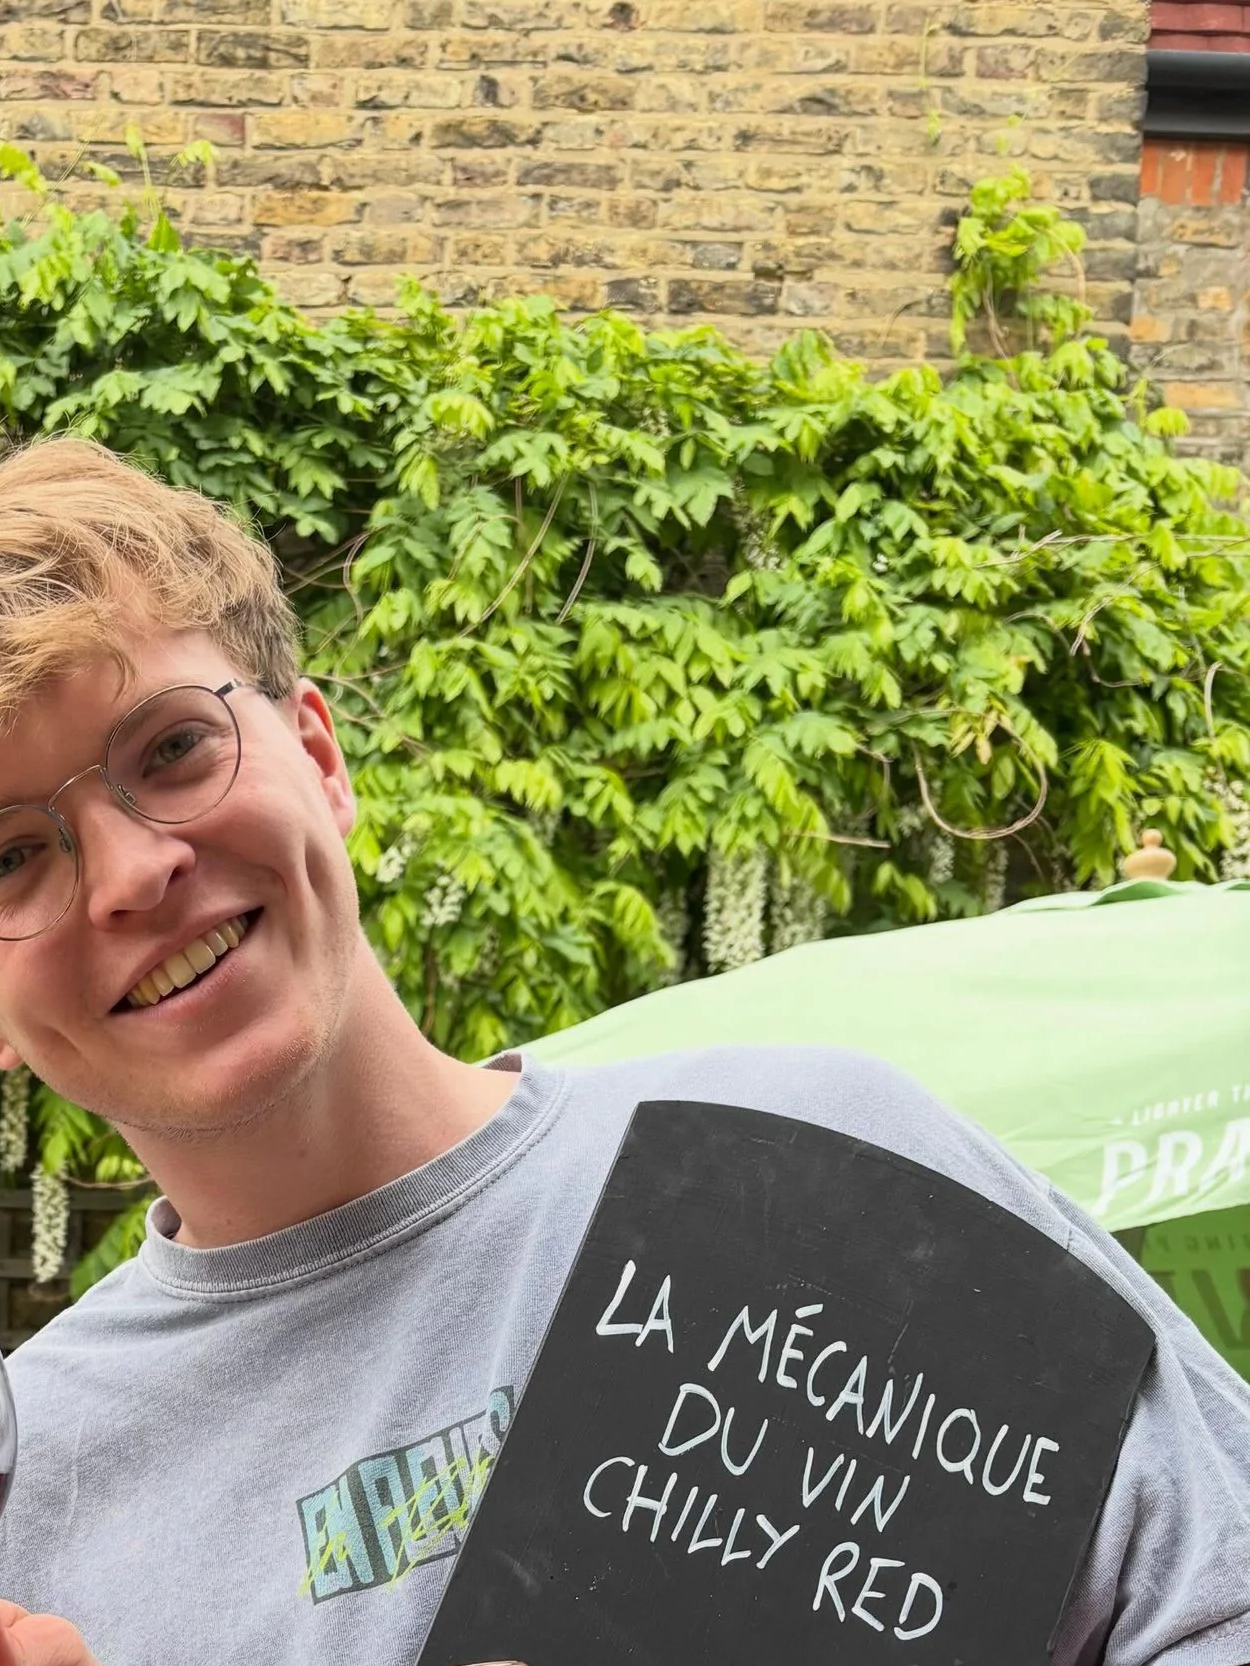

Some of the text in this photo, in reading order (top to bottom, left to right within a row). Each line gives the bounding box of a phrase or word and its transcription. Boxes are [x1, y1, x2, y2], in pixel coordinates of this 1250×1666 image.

[596, 1260, 674, 1353] LA
[708, 1303, 1060, 1505] MÉCANIQUE
[658, 1383, 910, 1533] DU VIN
[583, 1456, 800, 1569] CHILLY
[813, 1541, 943, 1640] RED
